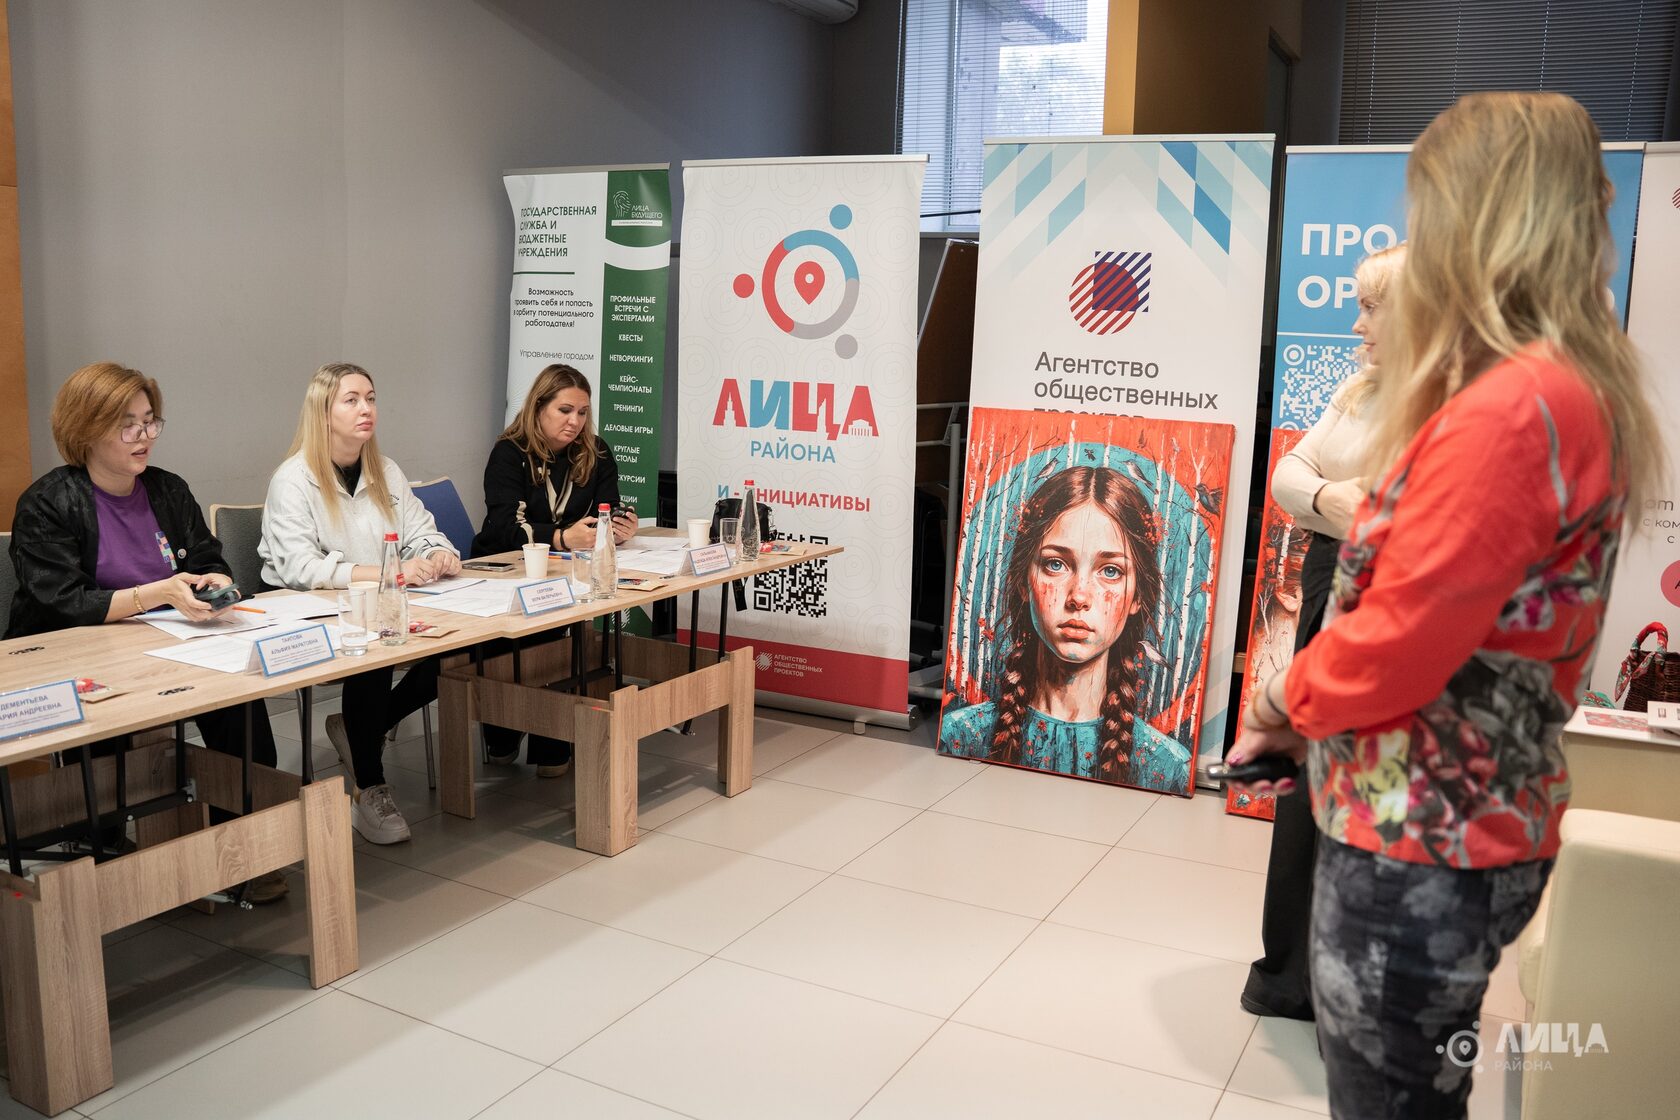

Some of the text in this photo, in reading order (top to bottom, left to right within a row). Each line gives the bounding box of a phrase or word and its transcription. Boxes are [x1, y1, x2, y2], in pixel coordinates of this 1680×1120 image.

[520, 206, 597, 217] ГОСУДАРСТВЕННАЯ
[550, 220, 557, 230] И
[528, 287, 574, 296] Возможность
[540, 298, 558, 306] себя
[610, 295, 656, 304] ПРОФИЛЬНЫЕ
[538, 310, 594, 318] потенциального
[614, 305, 649, 313] ВСТРЕЧИ С
[525, 318, 575, 328] работодателя!
[611, 314, 655, 323] ЭКСПЕРТАМИ
[618, 334, 643, 342] КВЕСТЫ
[519, 349, 595, 361] Управление городом
[609, 354, 654, 363] НЕТВОРКИНГИ
[1034, 351, 1159, 378] Агентство
[619, 375, 639, 383] КЕЙС-
[607, 384, 653, 394] ЧЕМПИОНАТЫ
[1034, 378, 1218, 410] общественных
[613, 404, 644, 413] ТРЕНИНГИ
[712, 378, 879, 441] ЛИЦА
[604, 424, 654, 435] ДЕЛОВЫЕ ИГРЫ
[613, 445, 641, 454] КРУГЛЫЕ
[750, 436, 836, 463] РАЙОНА
[615, 454, 638, 463] СТОЛЫ
[755, 487, 871, 512] НИЦИАТИВЫ
[774, 654, 807, 664] АГЕНТСТВО
[773, 660, 823, 673] ОБЩЕСТВЕННЫХ
[773, 667, 804, 677] ПРОЕКТОВ
[0, 695, 49, 711] ДЕМЕНТЬЕВА
[19, 702, 62, 716] АНДРЕЕВНА
